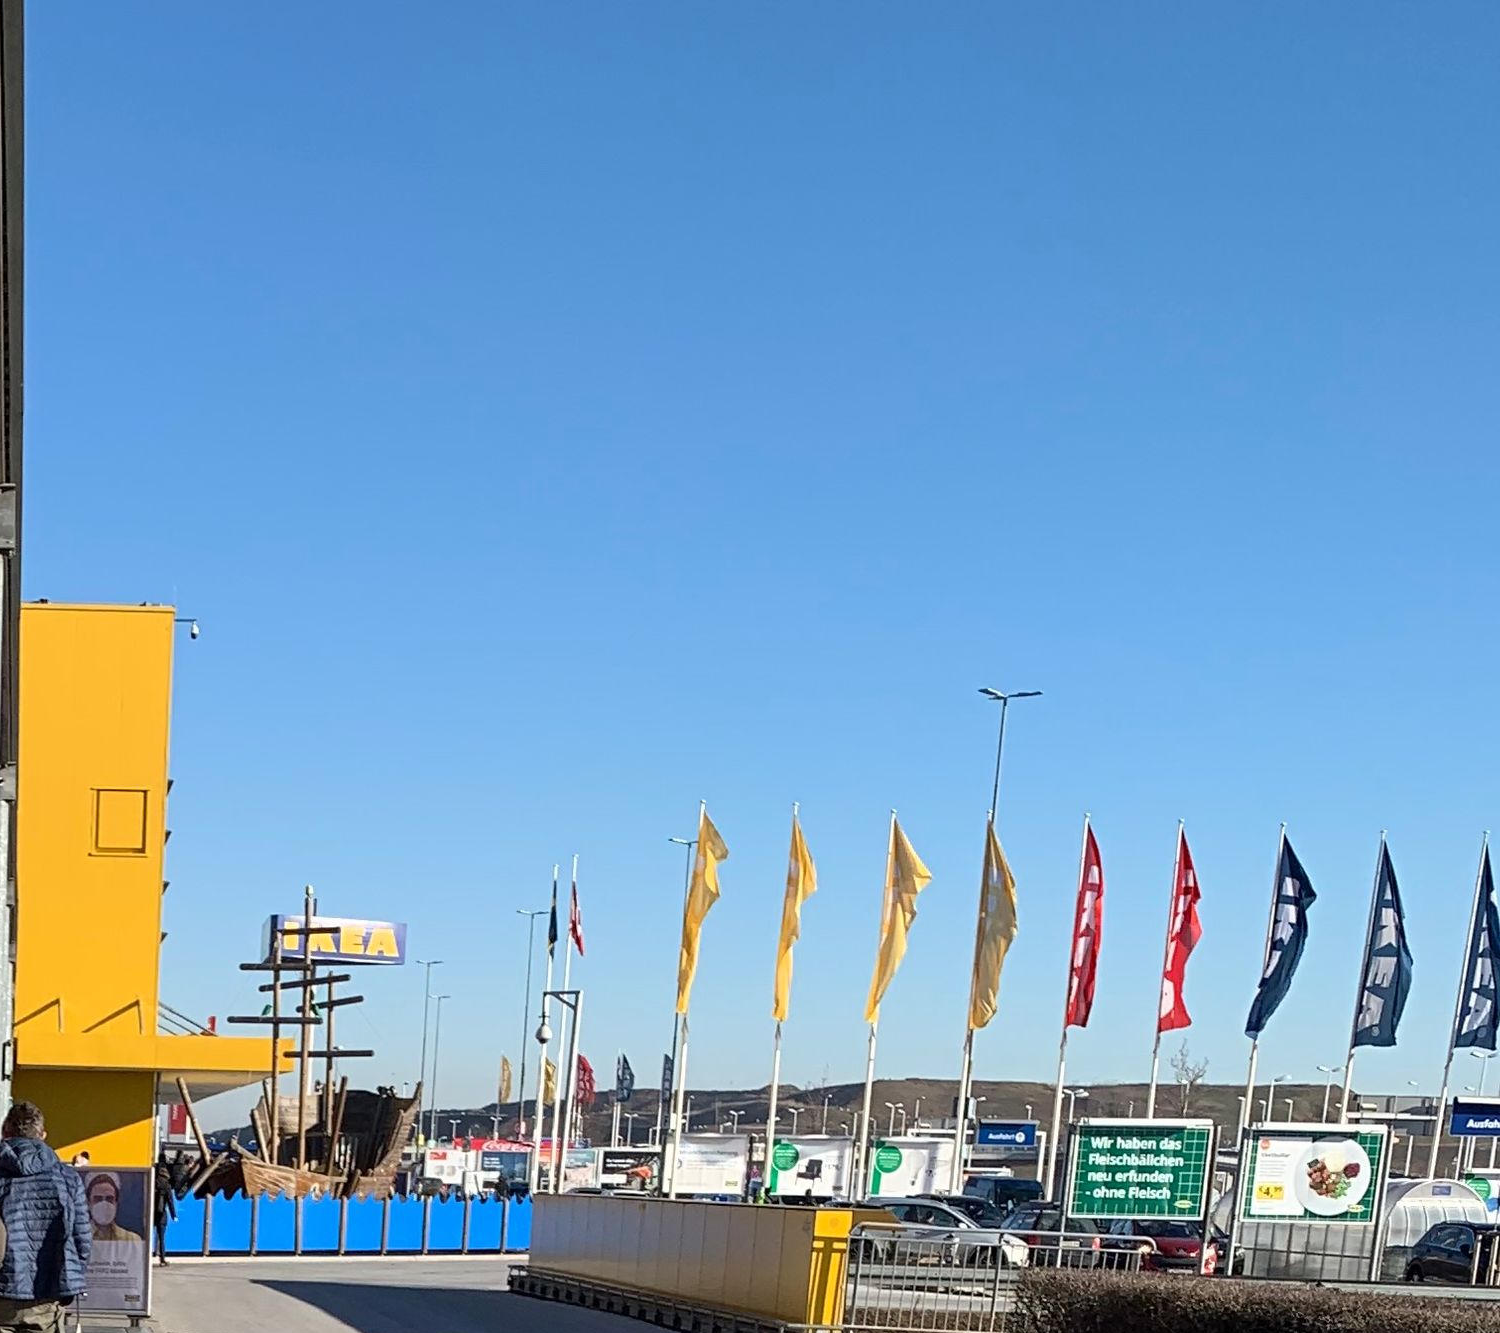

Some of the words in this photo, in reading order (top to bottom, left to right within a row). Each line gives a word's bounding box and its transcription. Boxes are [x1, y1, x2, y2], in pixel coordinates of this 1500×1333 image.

[283, 921, 400, 957] IKEA
[1090, 1136, 1114, 1149] Wir
[1116, 1137, 1157, 1150] haben
[1159, 1138, 1182, 1150] das
[1088, 1153, 1184, 1167] Fleischbällchen
[1087, 1171, 1112, 1182] neu
[1114, 1169, 1174, 1183] erfunden
[1092, 1186, 1126, 1199] ohne
[1128, 1187, 1171, 1199] Fleisch
